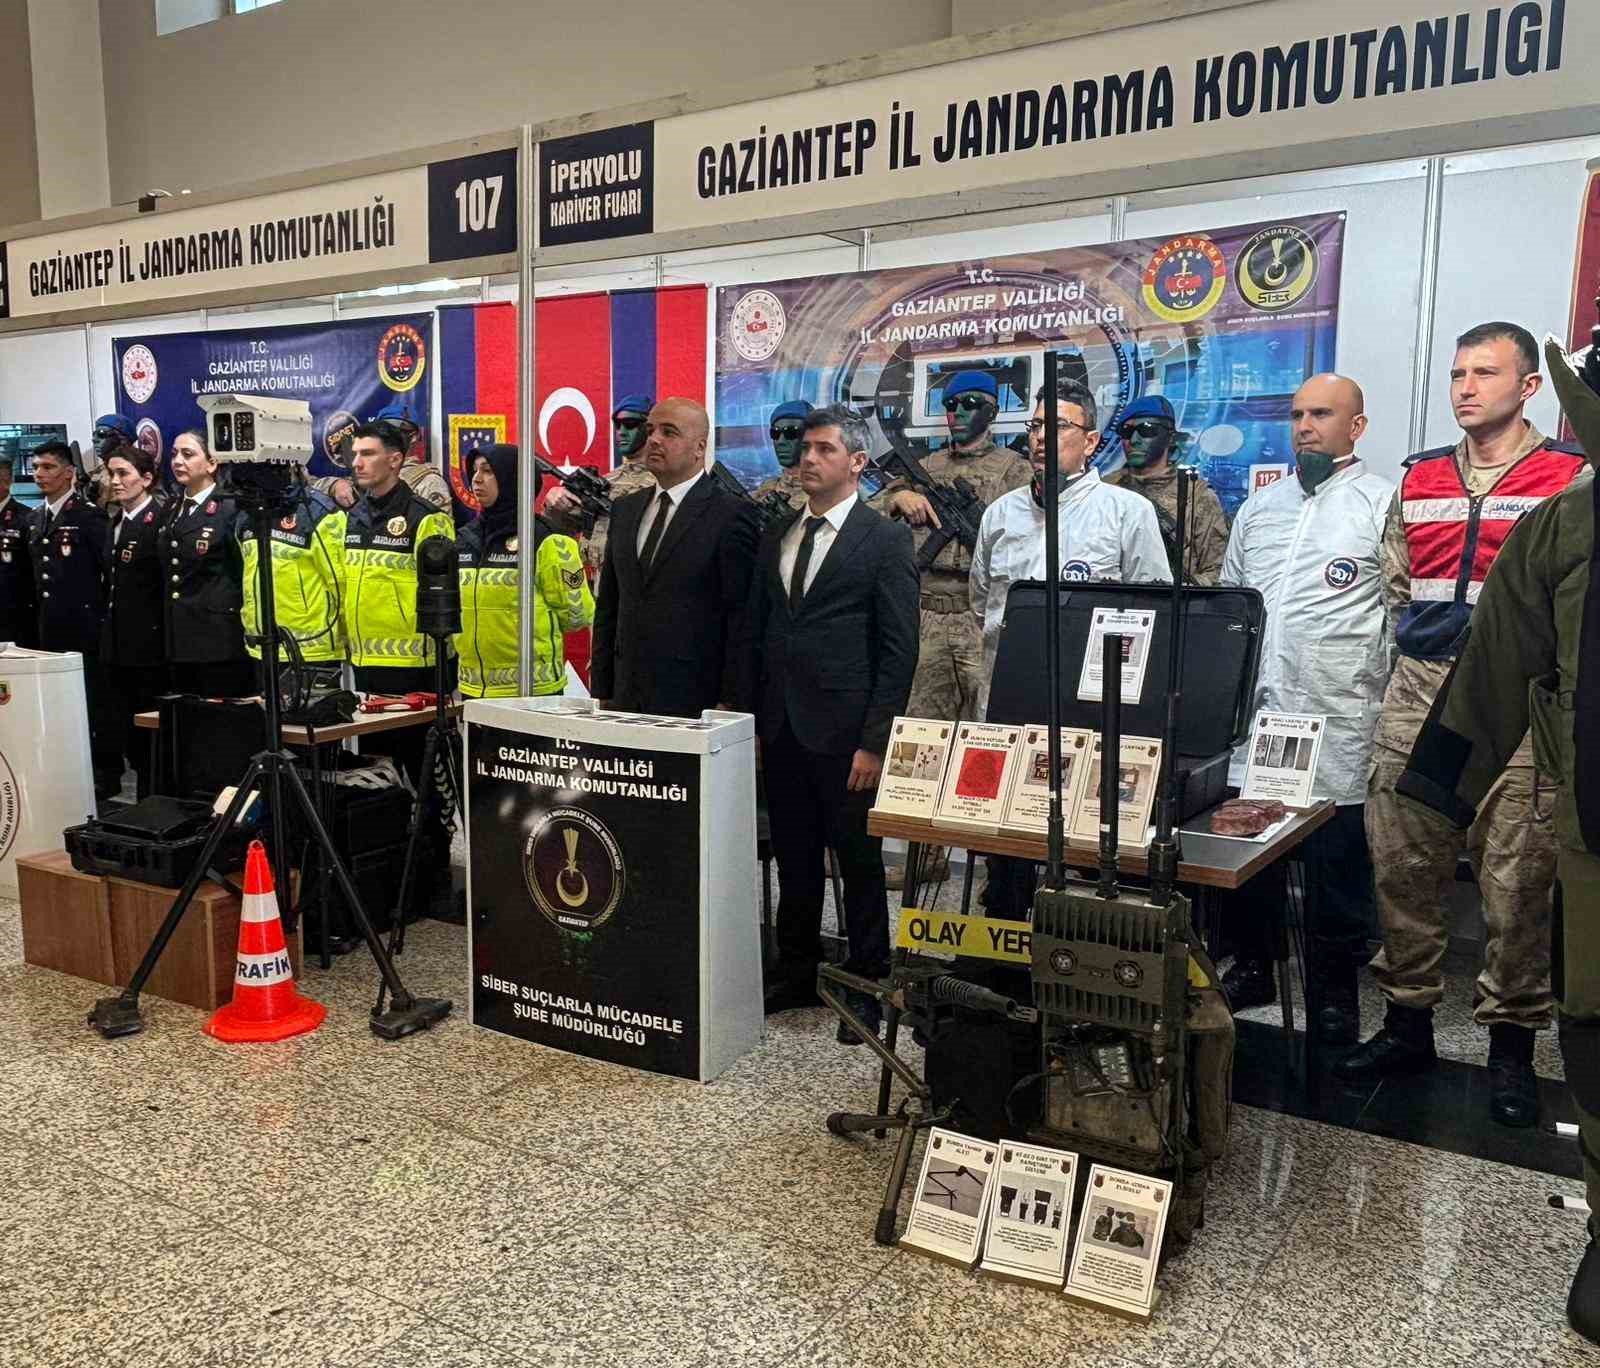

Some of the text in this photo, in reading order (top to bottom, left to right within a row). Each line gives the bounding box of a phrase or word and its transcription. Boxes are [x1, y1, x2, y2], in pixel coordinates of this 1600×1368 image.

[698, 118, 876, 199] GAZİANTEP
[889, 101, 921, 170] İL
[933, 65, 1174, 163] JANDARMA
[550, 149, 642, 194] İPEKYOLU
[455, 175, 504, 233] 107
[550, 188, 642, 227] KARİYER FUARI
[29, 249, 114, 297] GAZİANTEP
[120, 238, 135, 283] İL
[139, 227, 243, 280] JANDARMA
[250, 194, 394, 265] KOMUTANLIĞI
[1148, 238, 1221, 276] JANDARMA
[965, 268, 1000, 285] T.C.
[891, 280, 1085, 318] GAZİANTEP VALİLİĞİ
[860, 303, 1124, 345] İL JANDARMA KOMUTANLIĞI
[208, 353, 313, 376] GAZİANTEP VALİLİĞİ
[250, 341, 269, 354] T.C.
[191, 372, 336, 394] İL JANDARMA KOMUTANLIĞI
[476, 759, 688, 802] İL JANDARMA KOMUTANLIĞI
[498, 746, 654, 778] GAZİANTEP VALİLİĞİ
[909, 918, 966, 946] OLAY
[481, 974, 683, 1034] SİBER SUÇLARLA MÜCADELE
[513, 1002, 646, 1046] ŞUBE MÜDÜRLÜĞÜ
